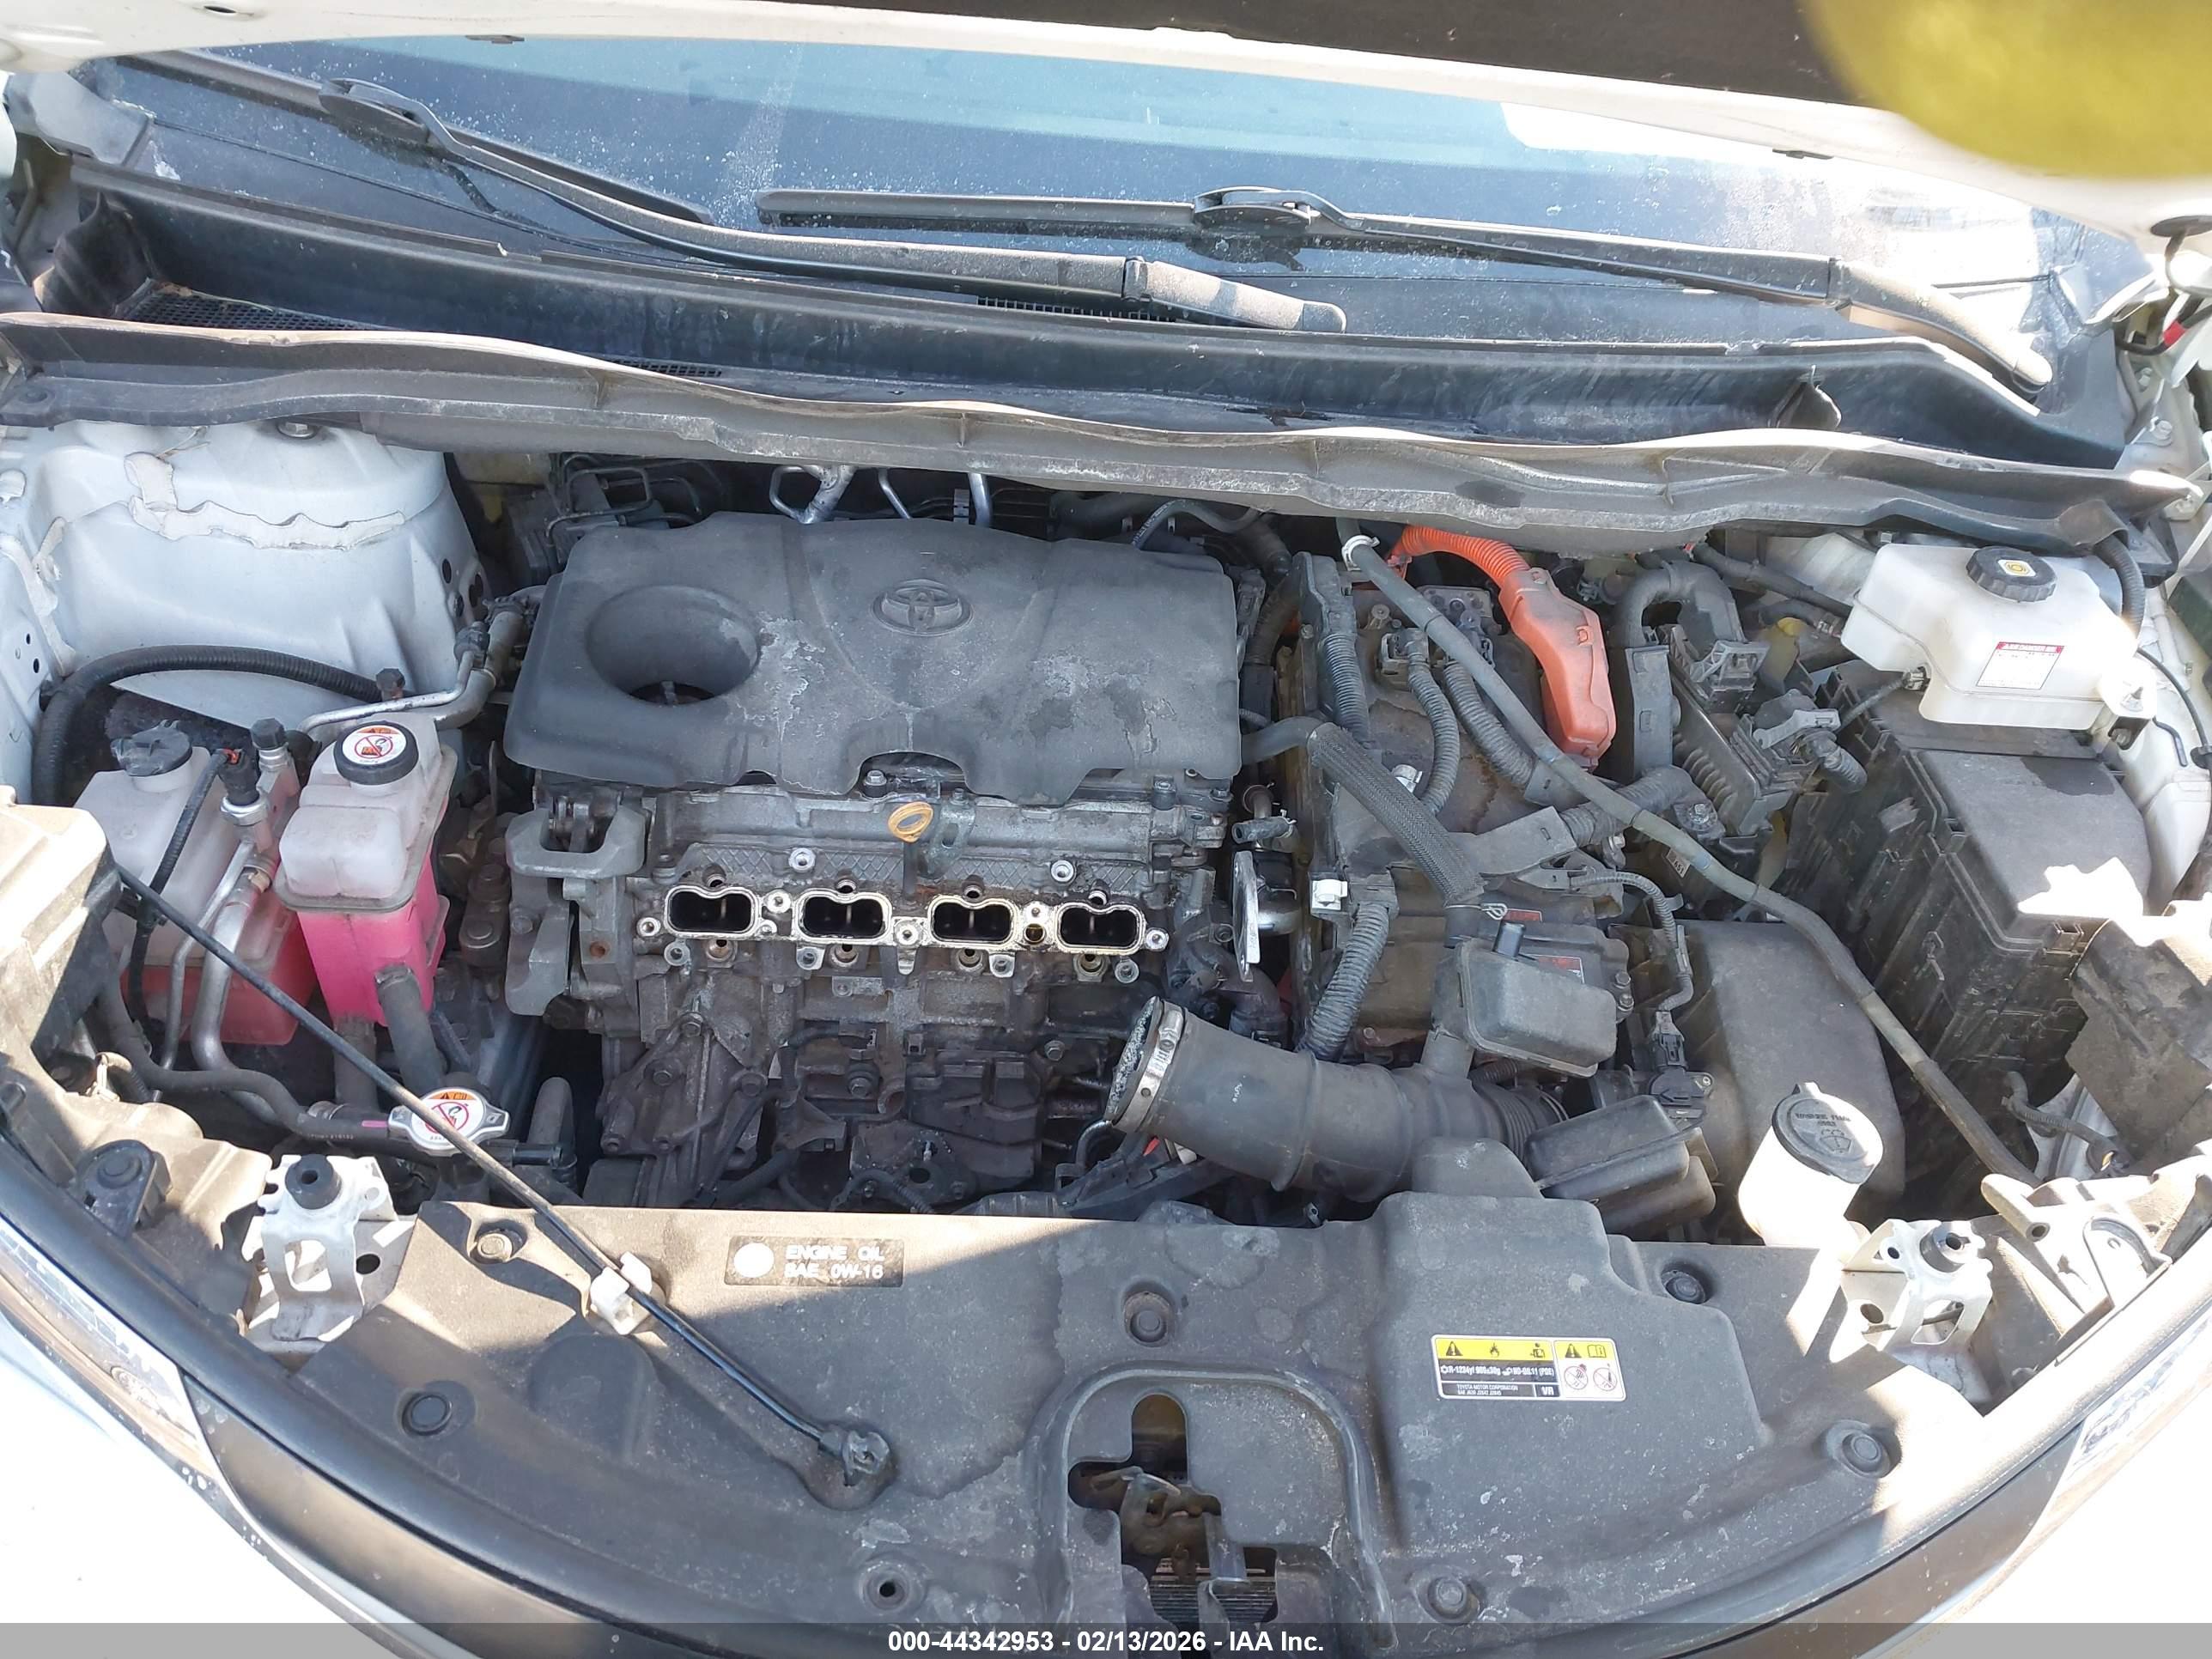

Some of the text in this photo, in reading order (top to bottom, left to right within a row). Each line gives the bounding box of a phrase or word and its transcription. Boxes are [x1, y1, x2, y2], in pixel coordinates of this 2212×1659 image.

[785, 1244, 885, 1261] ENGINE OIL
[784, 1262, 884, 1279] SAE 0W-16
